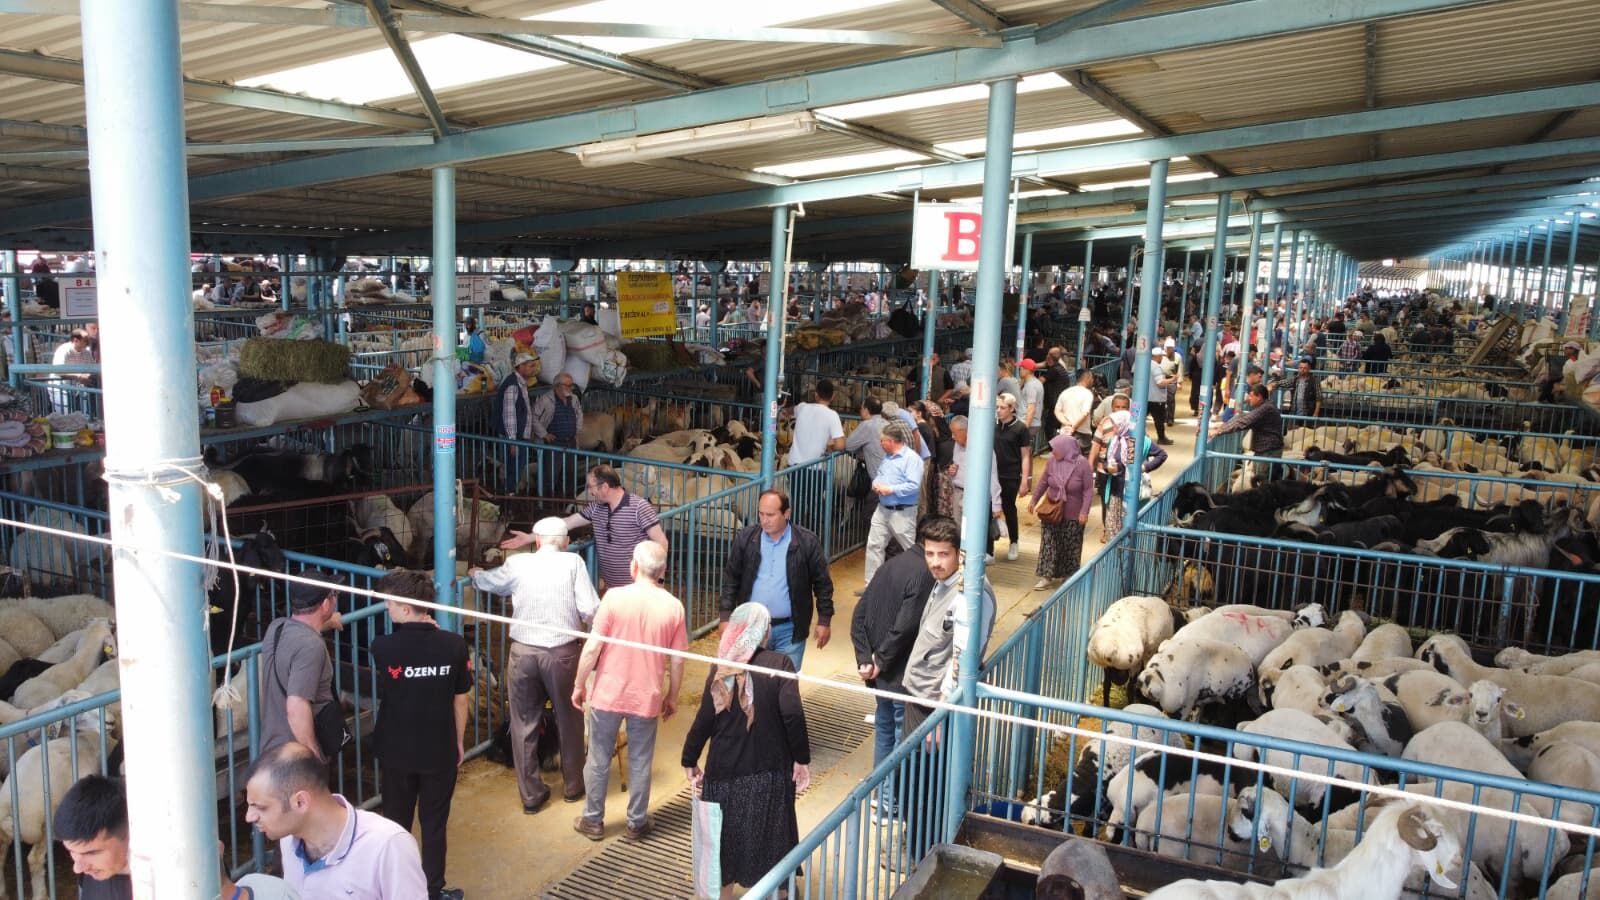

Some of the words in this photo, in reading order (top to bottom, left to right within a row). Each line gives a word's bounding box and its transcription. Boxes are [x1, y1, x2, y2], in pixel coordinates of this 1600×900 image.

[941, 211, 983, 262] B
[75, 279, 82, 287] B
[404, 665, 437, 678] ÖZEN
[439, 665, 451, 676] ET
